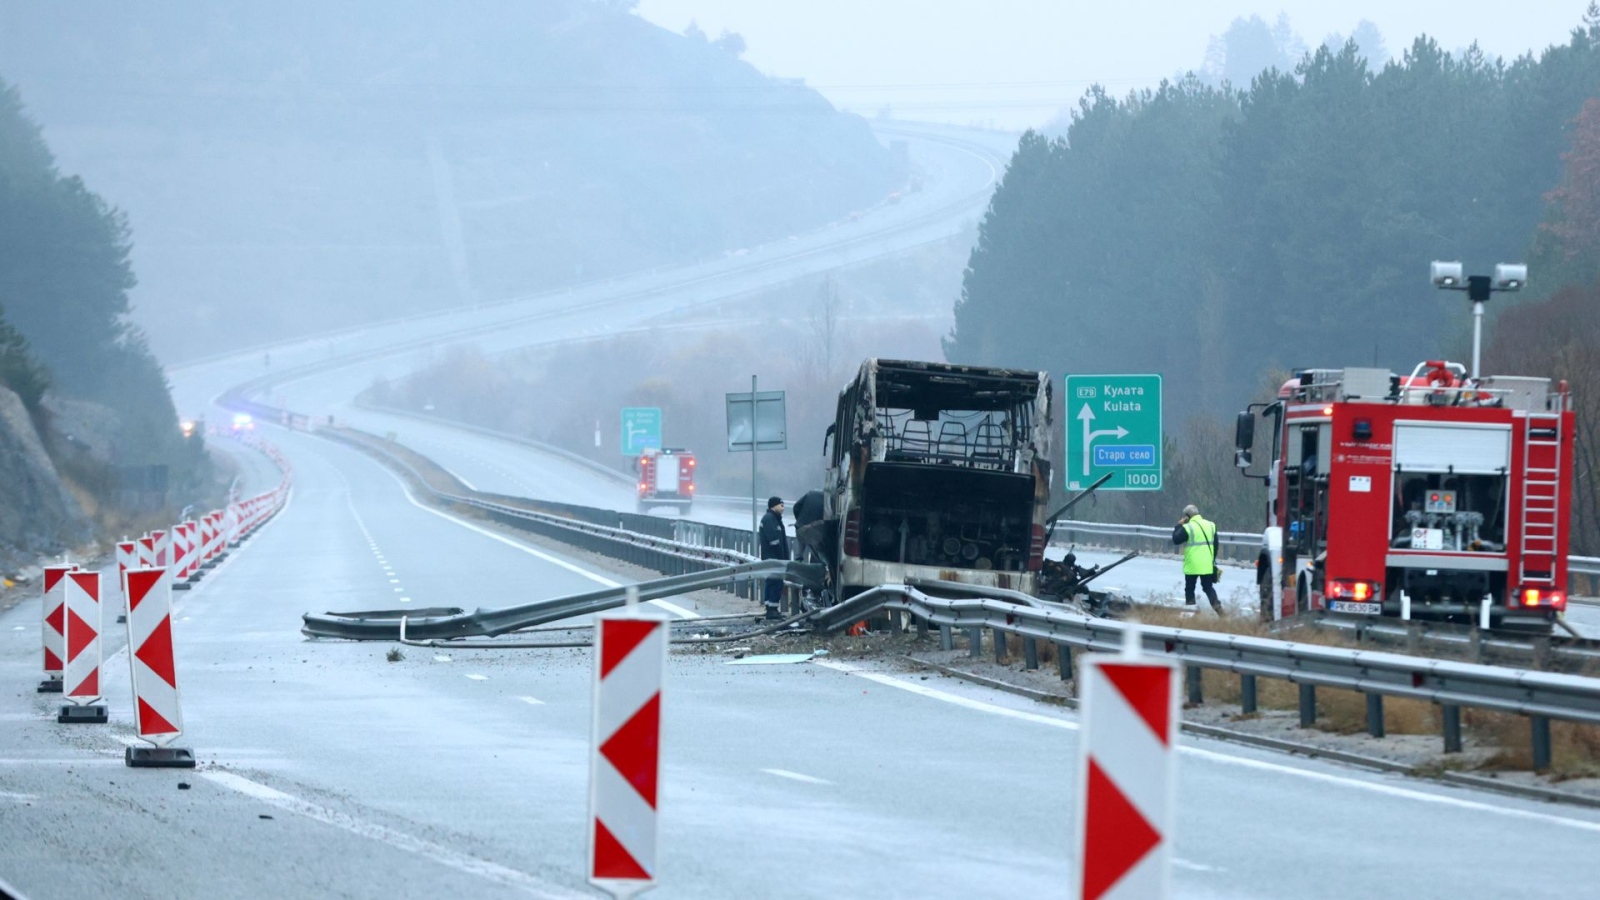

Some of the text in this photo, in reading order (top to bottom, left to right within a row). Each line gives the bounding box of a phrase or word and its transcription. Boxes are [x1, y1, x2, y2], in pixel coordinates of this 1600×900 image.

[1079, 388, 1094, 396] E79
[1104, 385, 1144, 397] Кулата
[1104, 401, 1141, 411] Kulata
[1099, 449, 1150, 462] Старо село
[1128, 474, 1157, 485] 1000
